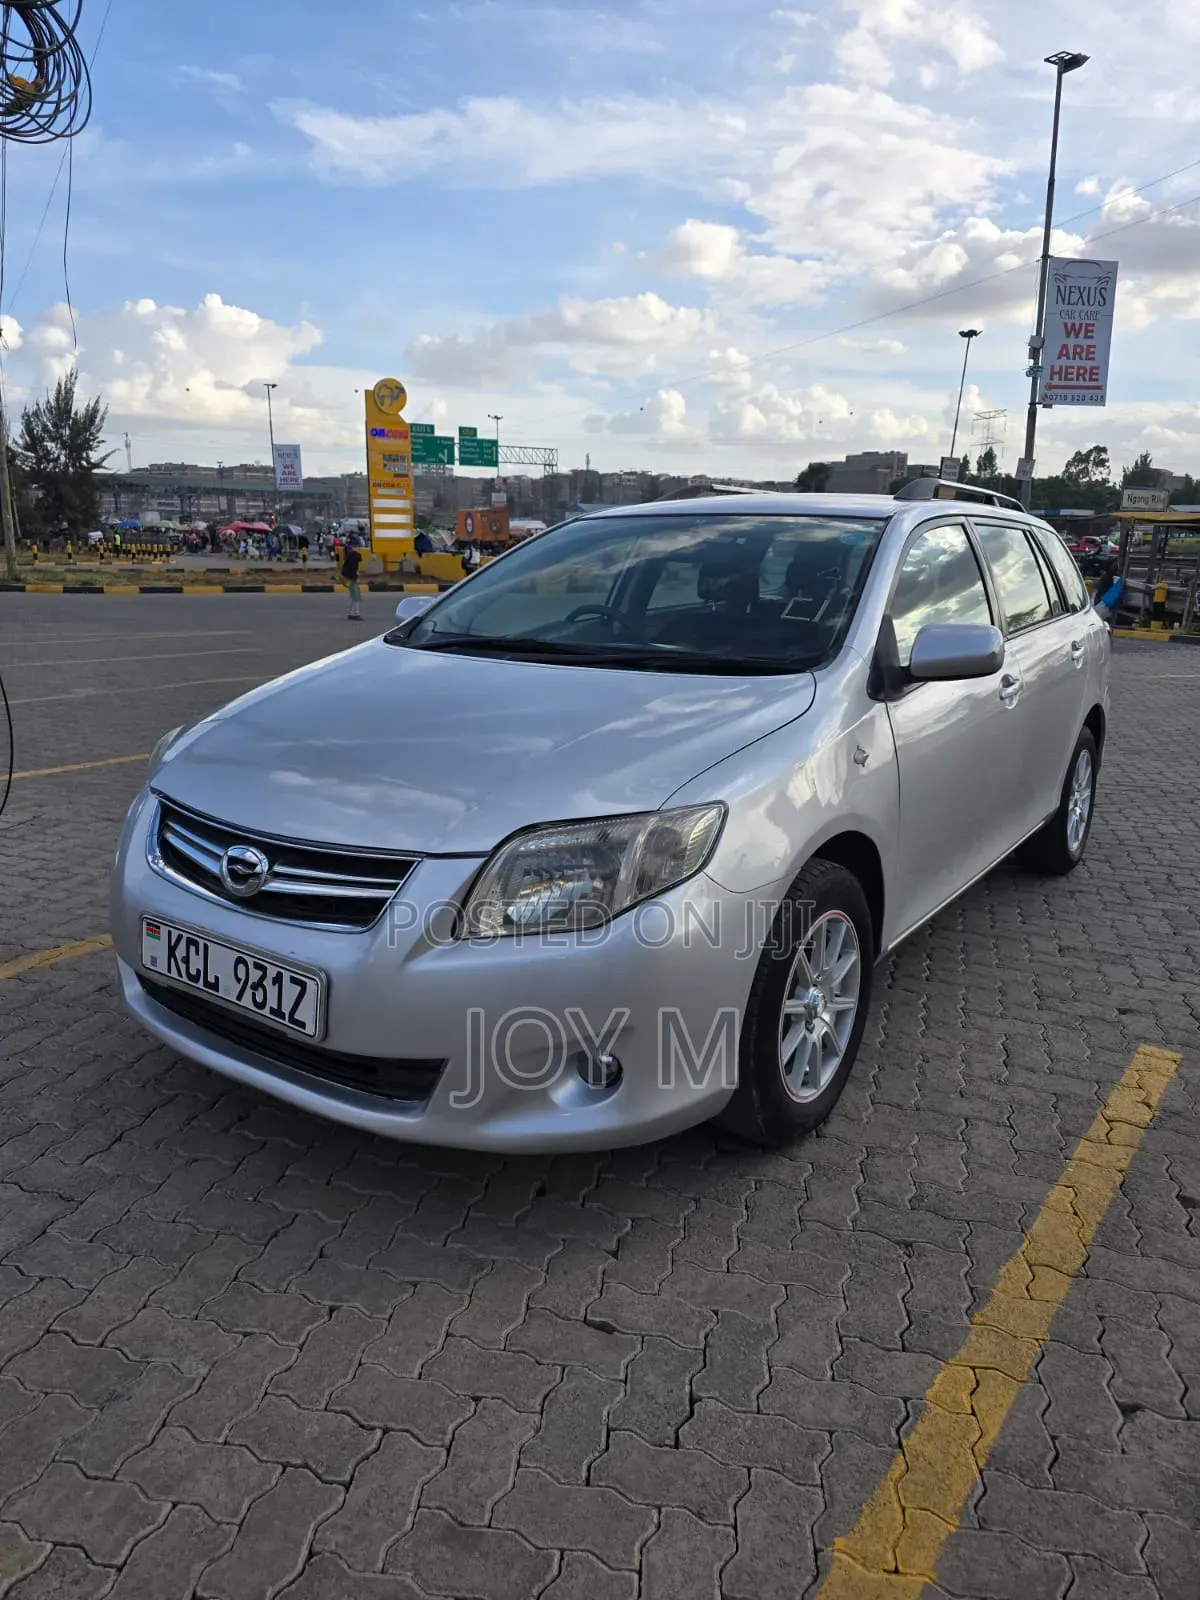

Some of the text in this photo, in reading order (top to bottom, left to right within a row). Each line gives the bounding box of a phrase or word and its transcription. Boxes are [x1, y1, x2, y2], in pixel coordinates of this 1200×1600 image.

[1055, 285, 1107, 307] NEXUS
[1059, 309, 1100, 321] CAR CARE
[1063, 322, 1096, 339] WE
[1056, 343, 1097, 361] ARE
[1049, 365, 1101, 382] HERE
[167, 929, 308, 1031] KCL 931Z
